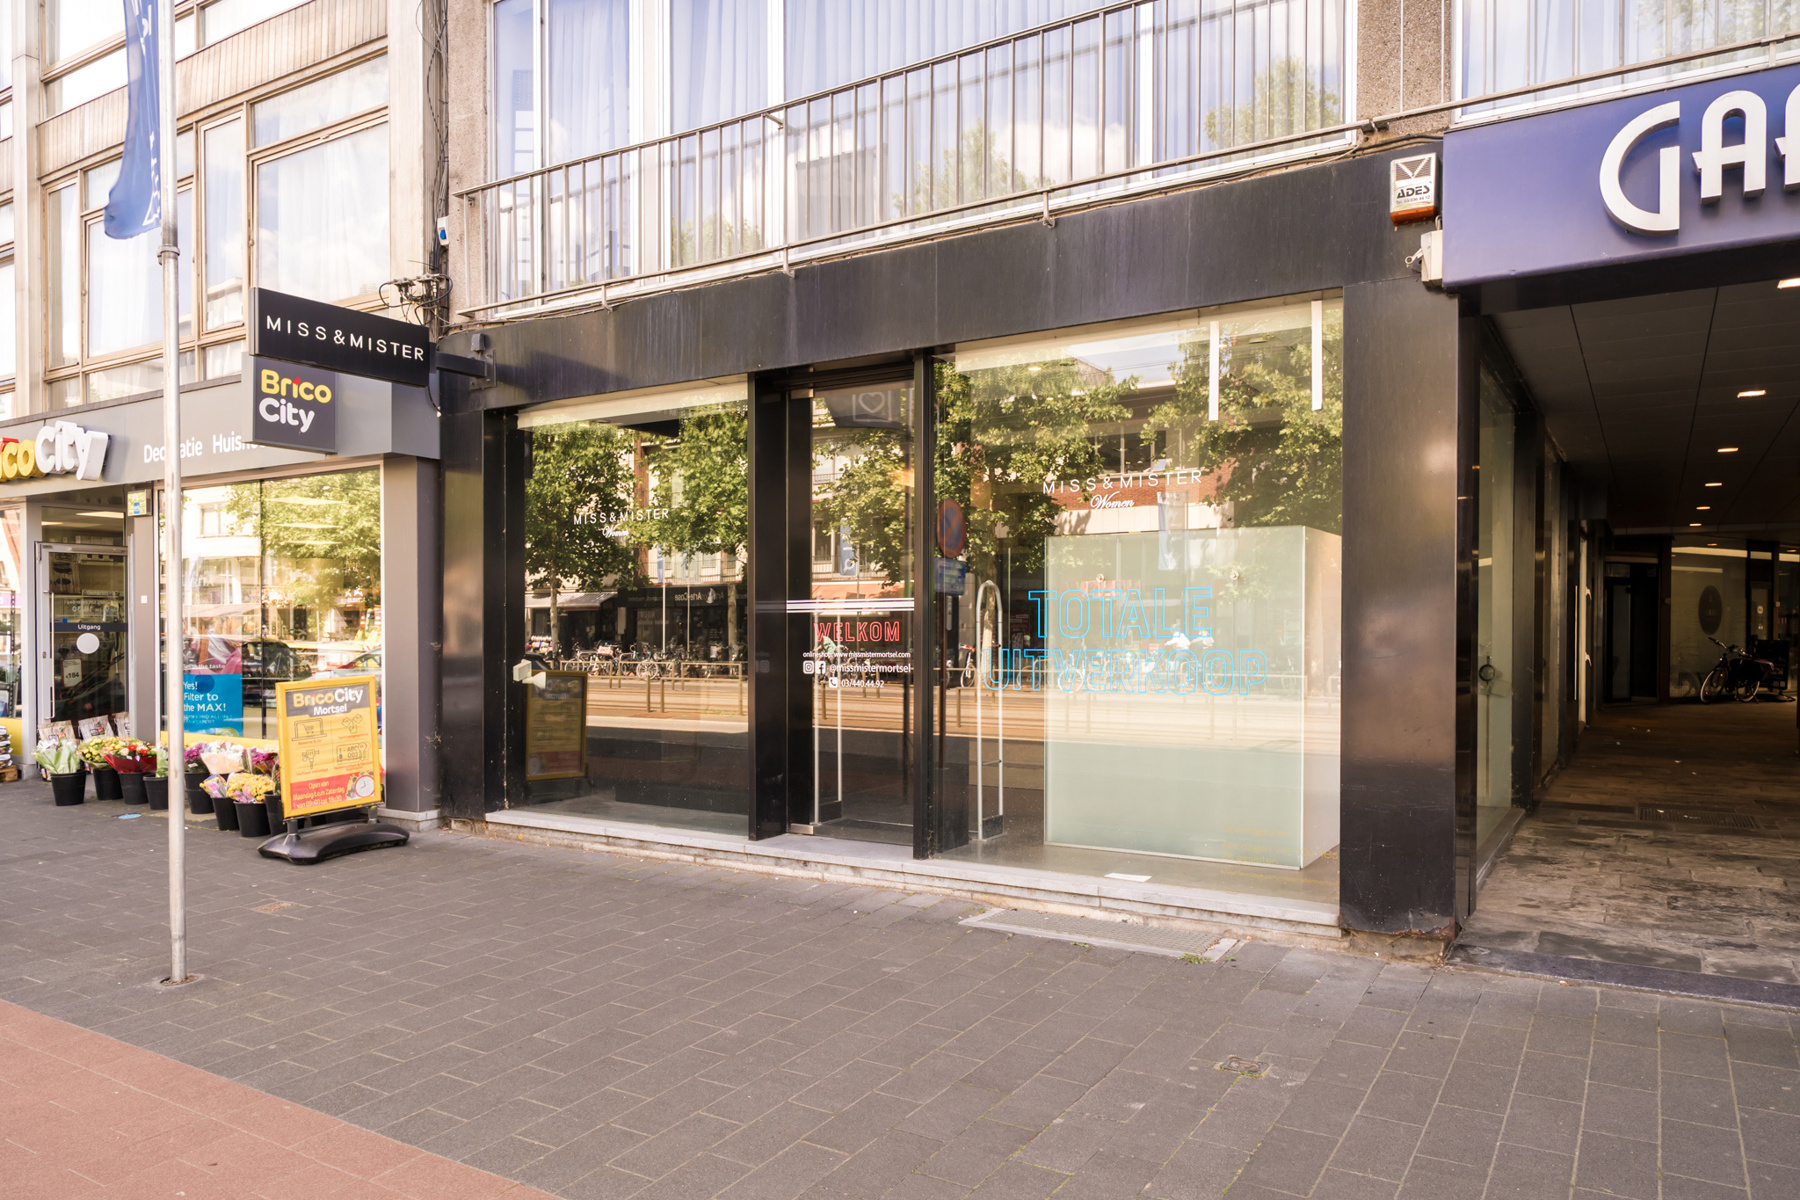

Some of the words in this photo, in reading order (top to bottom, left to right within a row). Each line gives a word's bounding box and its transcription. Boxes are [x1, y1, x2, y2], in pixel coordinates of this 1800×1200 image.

[1600, 84, 1800, 234] GA
[1397, 185, 1430, 199] ADES
[266, 315, 424, 361] MISS&MISTER
[261, 369, 332, 404] Brico
[259, 397, 315, 433] City
[143, 437, 203, 463] Decatie
[1090, 491, 1135, 510] Women
[573, 508, 669, 525] MISS&MISTER
[602, 524, 629, 538] Women
[1028, 587, 1212, 639] TOTALE
[813, 621, 900, 642] WELKOM
[829, 663, 911, 673] @missmistermortsel
[982, 648, 1268, 696] UITVERKOOP
[184, 692, 205, 701] Filter
[207, 691, 219, 701] to
[293, 687, 363, 708] BricoCity
[184, 702, 195, 712] the
[197, 702, 226, 712] MAX!
[313, 704, 348, 716] Mortsel
[308, 782, 320, 790] Open
